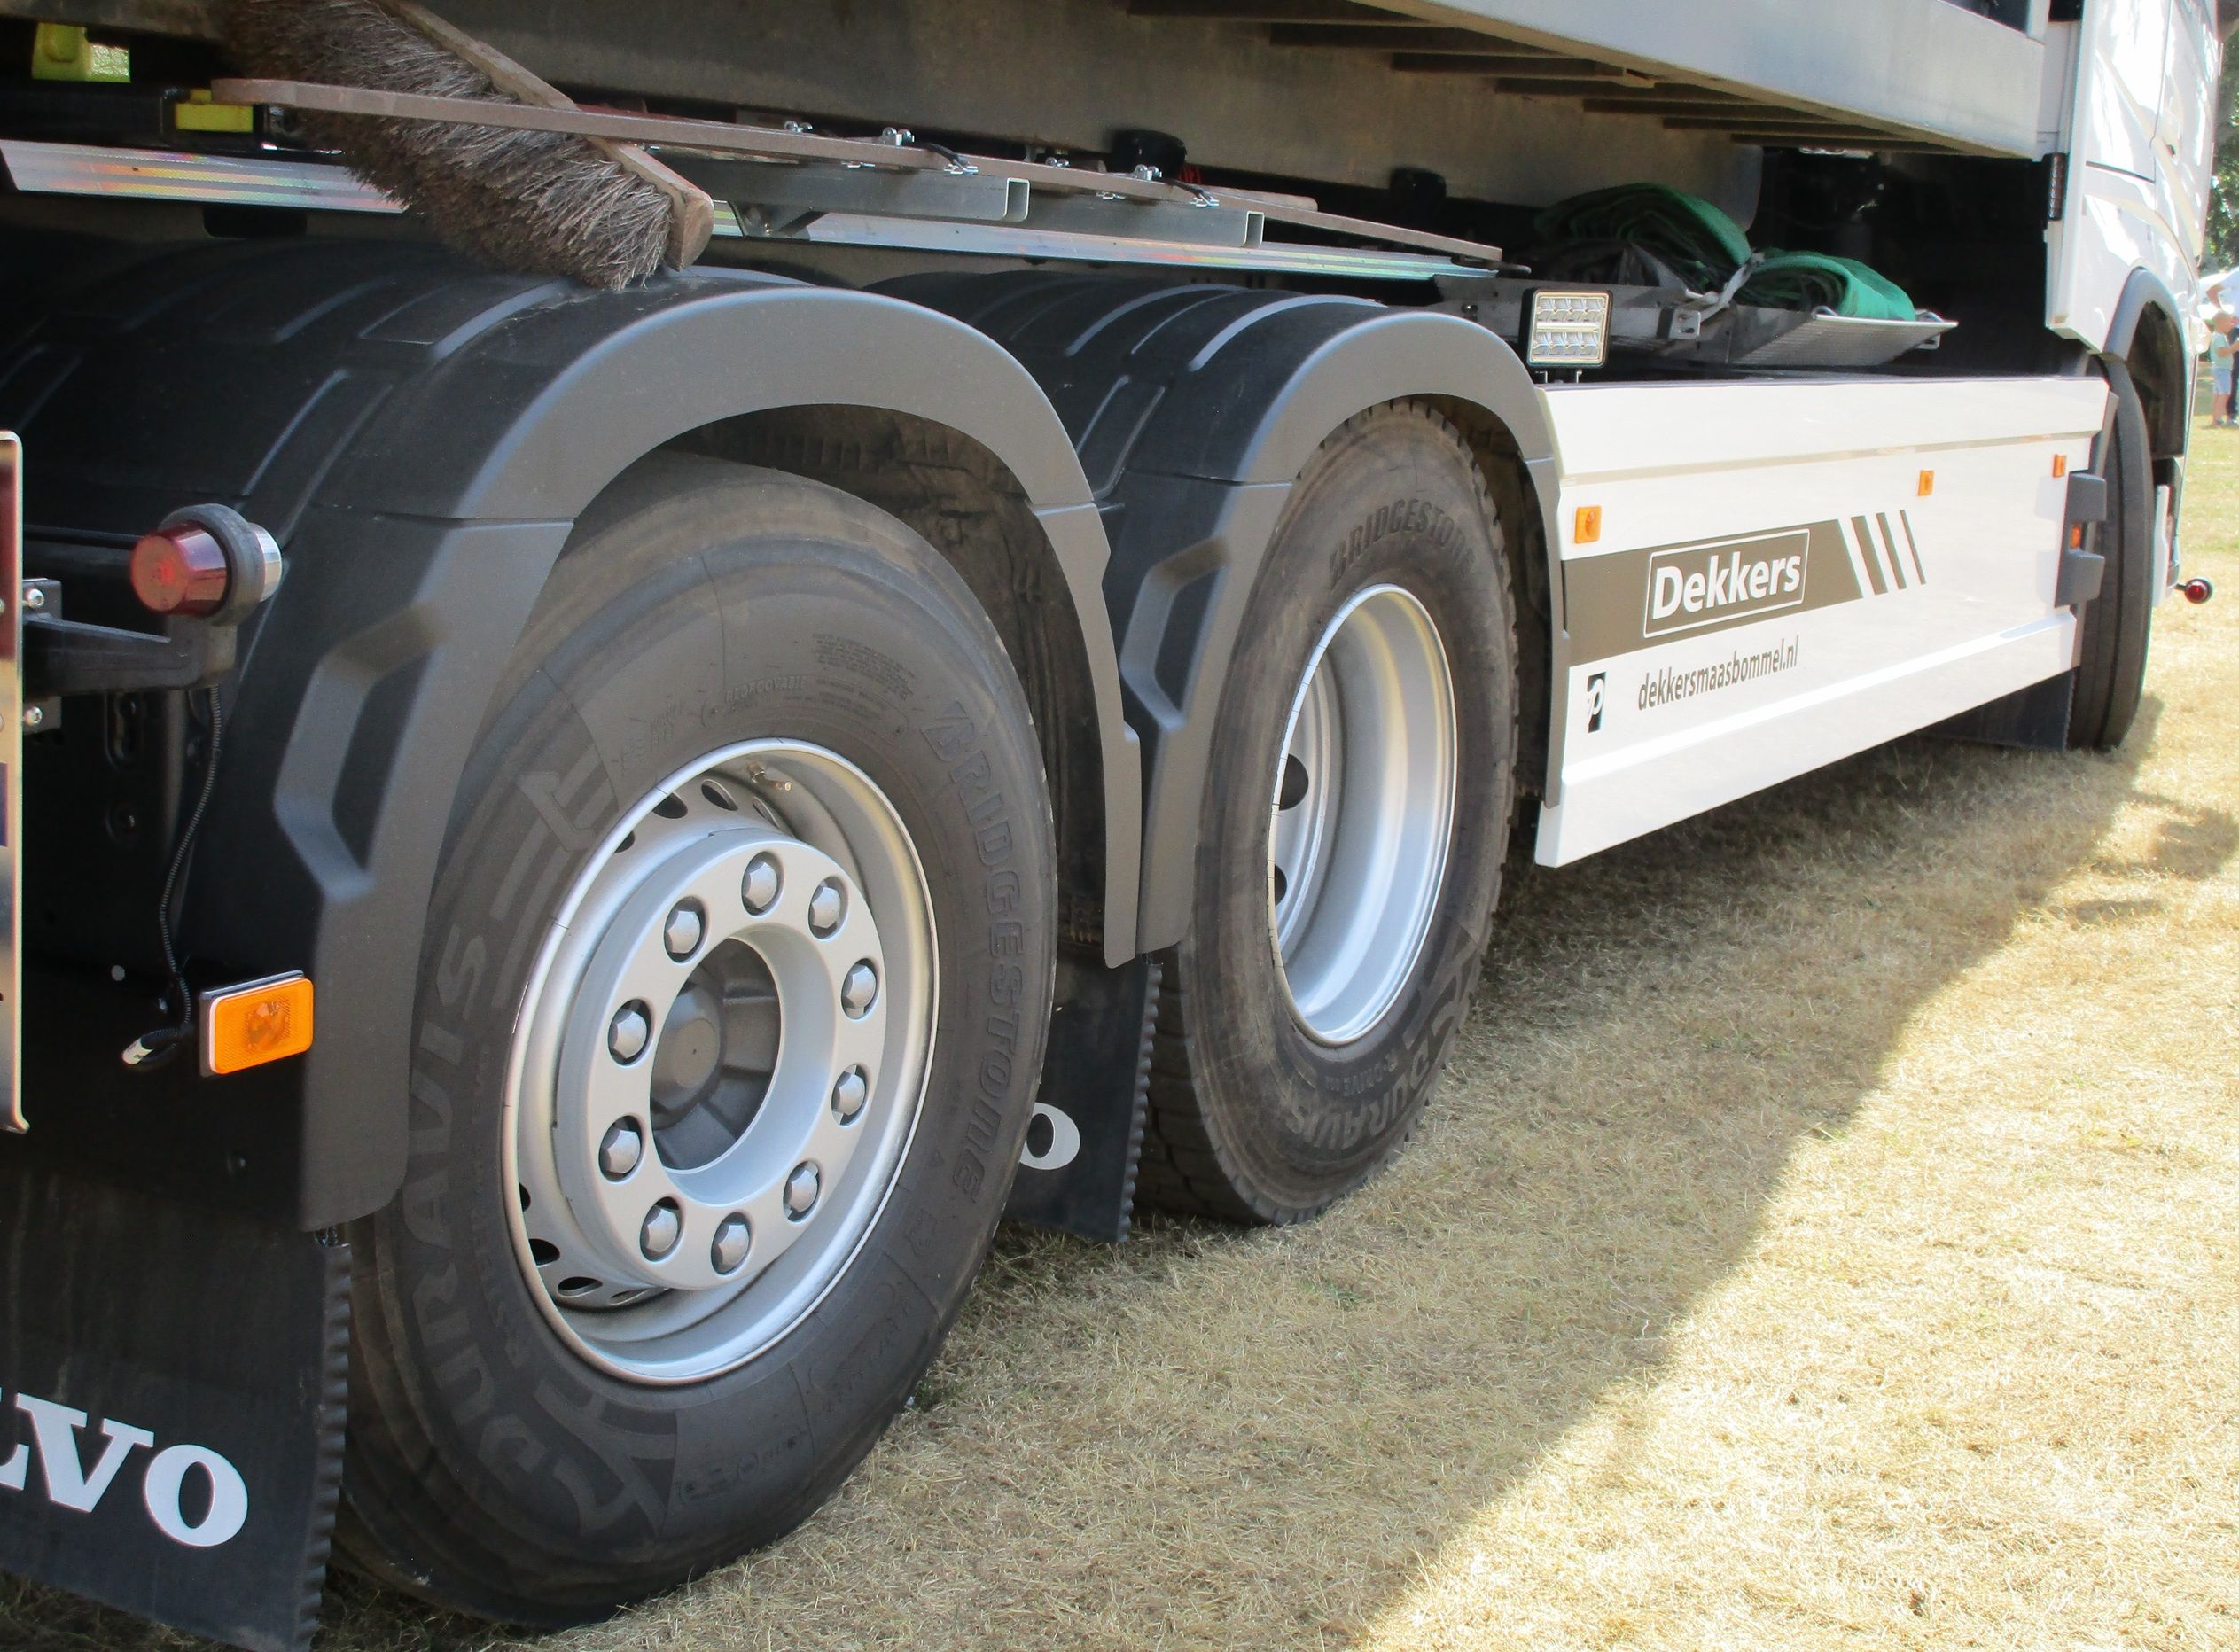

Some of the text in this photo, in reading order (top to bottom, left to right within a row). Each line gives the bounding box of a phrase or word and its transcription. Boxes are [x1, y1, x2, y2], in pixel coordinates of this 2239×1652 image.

[1330, 498, 1474, 585] BRIDGESTONE
[1652, 552, 1802, 620] Dekkers
[1638, 634, 1800, 711] dekkersmaasbommel.nl
[918, 697, 1026, 1204] BRIDGESTONE
[404, 923, 548, 1480] DURAVIS
